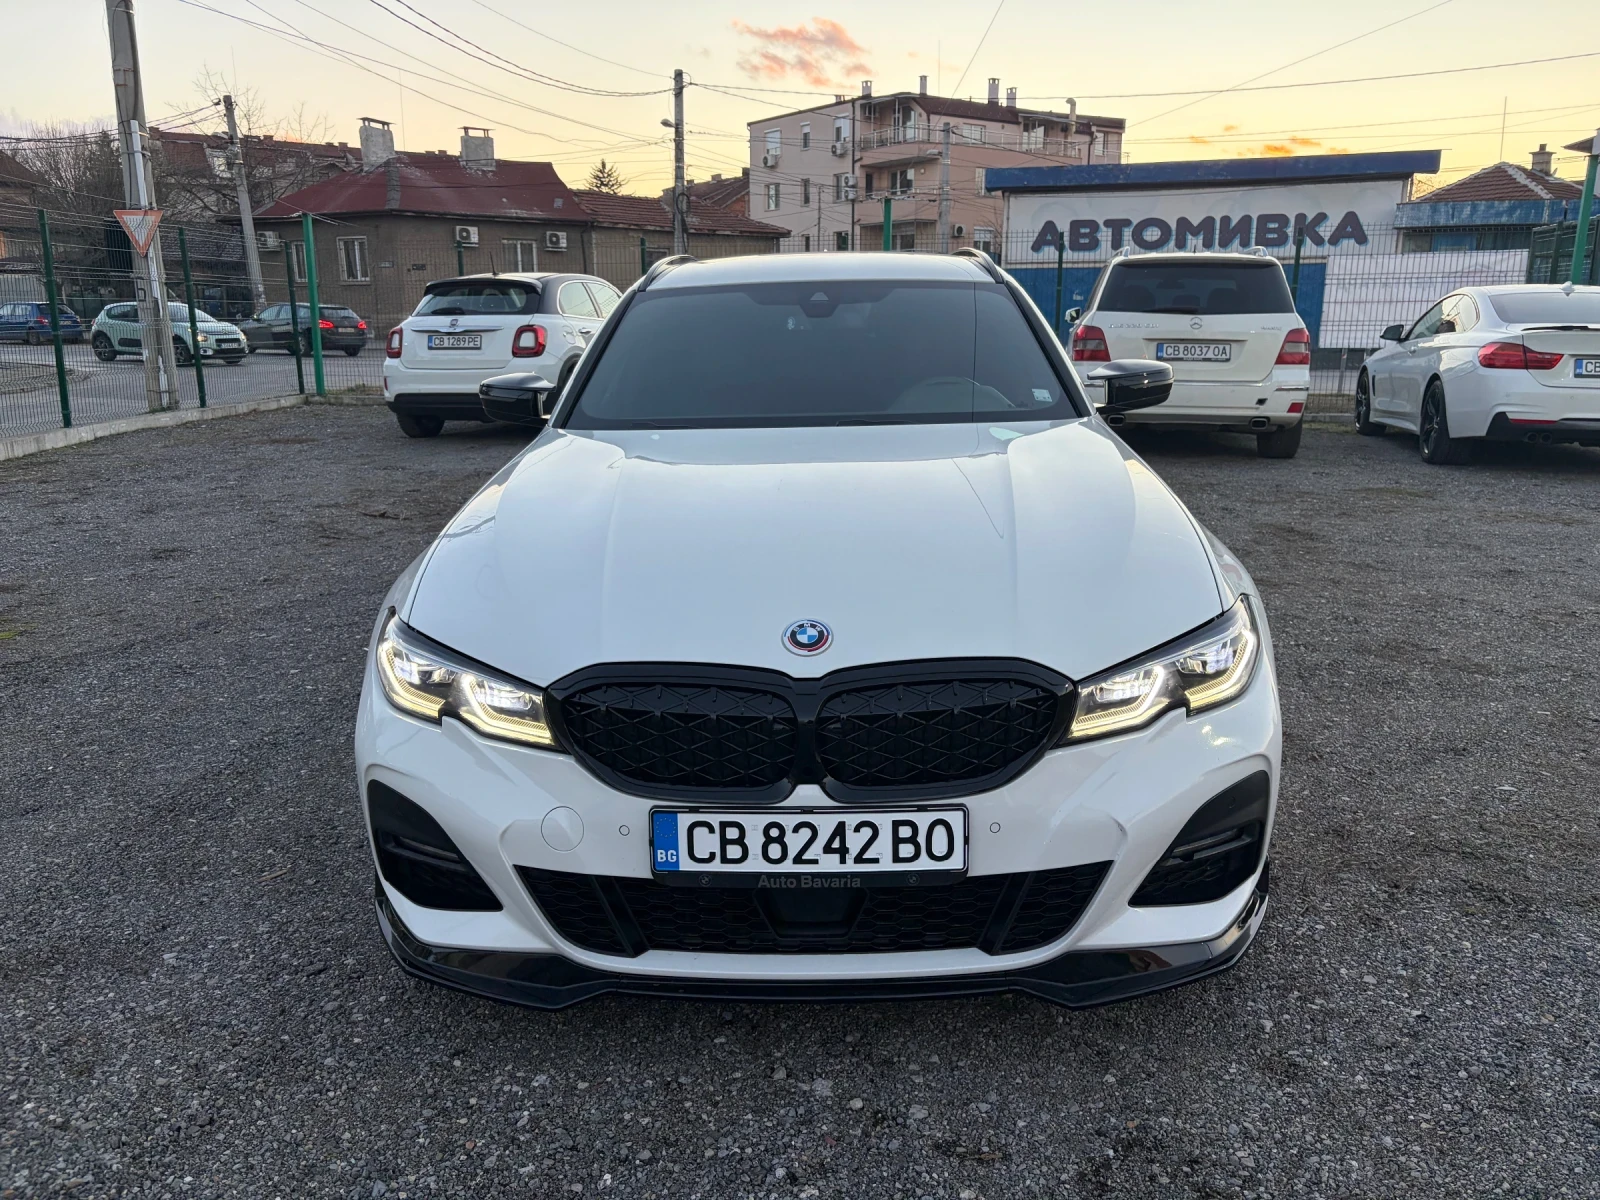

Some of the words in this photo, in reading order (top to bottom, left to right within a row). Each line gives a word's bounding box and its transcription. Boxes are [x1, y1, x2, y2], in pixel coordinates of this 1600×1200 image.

[1030, 210, 1369, 253] АВТОМИВКА
[434, 337, 445, 346] CB
[447, 337, 466, 346] 1289
[468, 337, 478, 346] PE
[1165, 345, 1180, 356] CB
[1182, 345, 1210, 357] 8037
[793, 622, 823, 631] BMW
[687, 820, 749, 865] CB
[761, 820, 880, 865] 8242
[657, 849, 677, 863] BG
[757, 874, 797, 888] Auto
[801, 874, 861, 888] Bavaria
